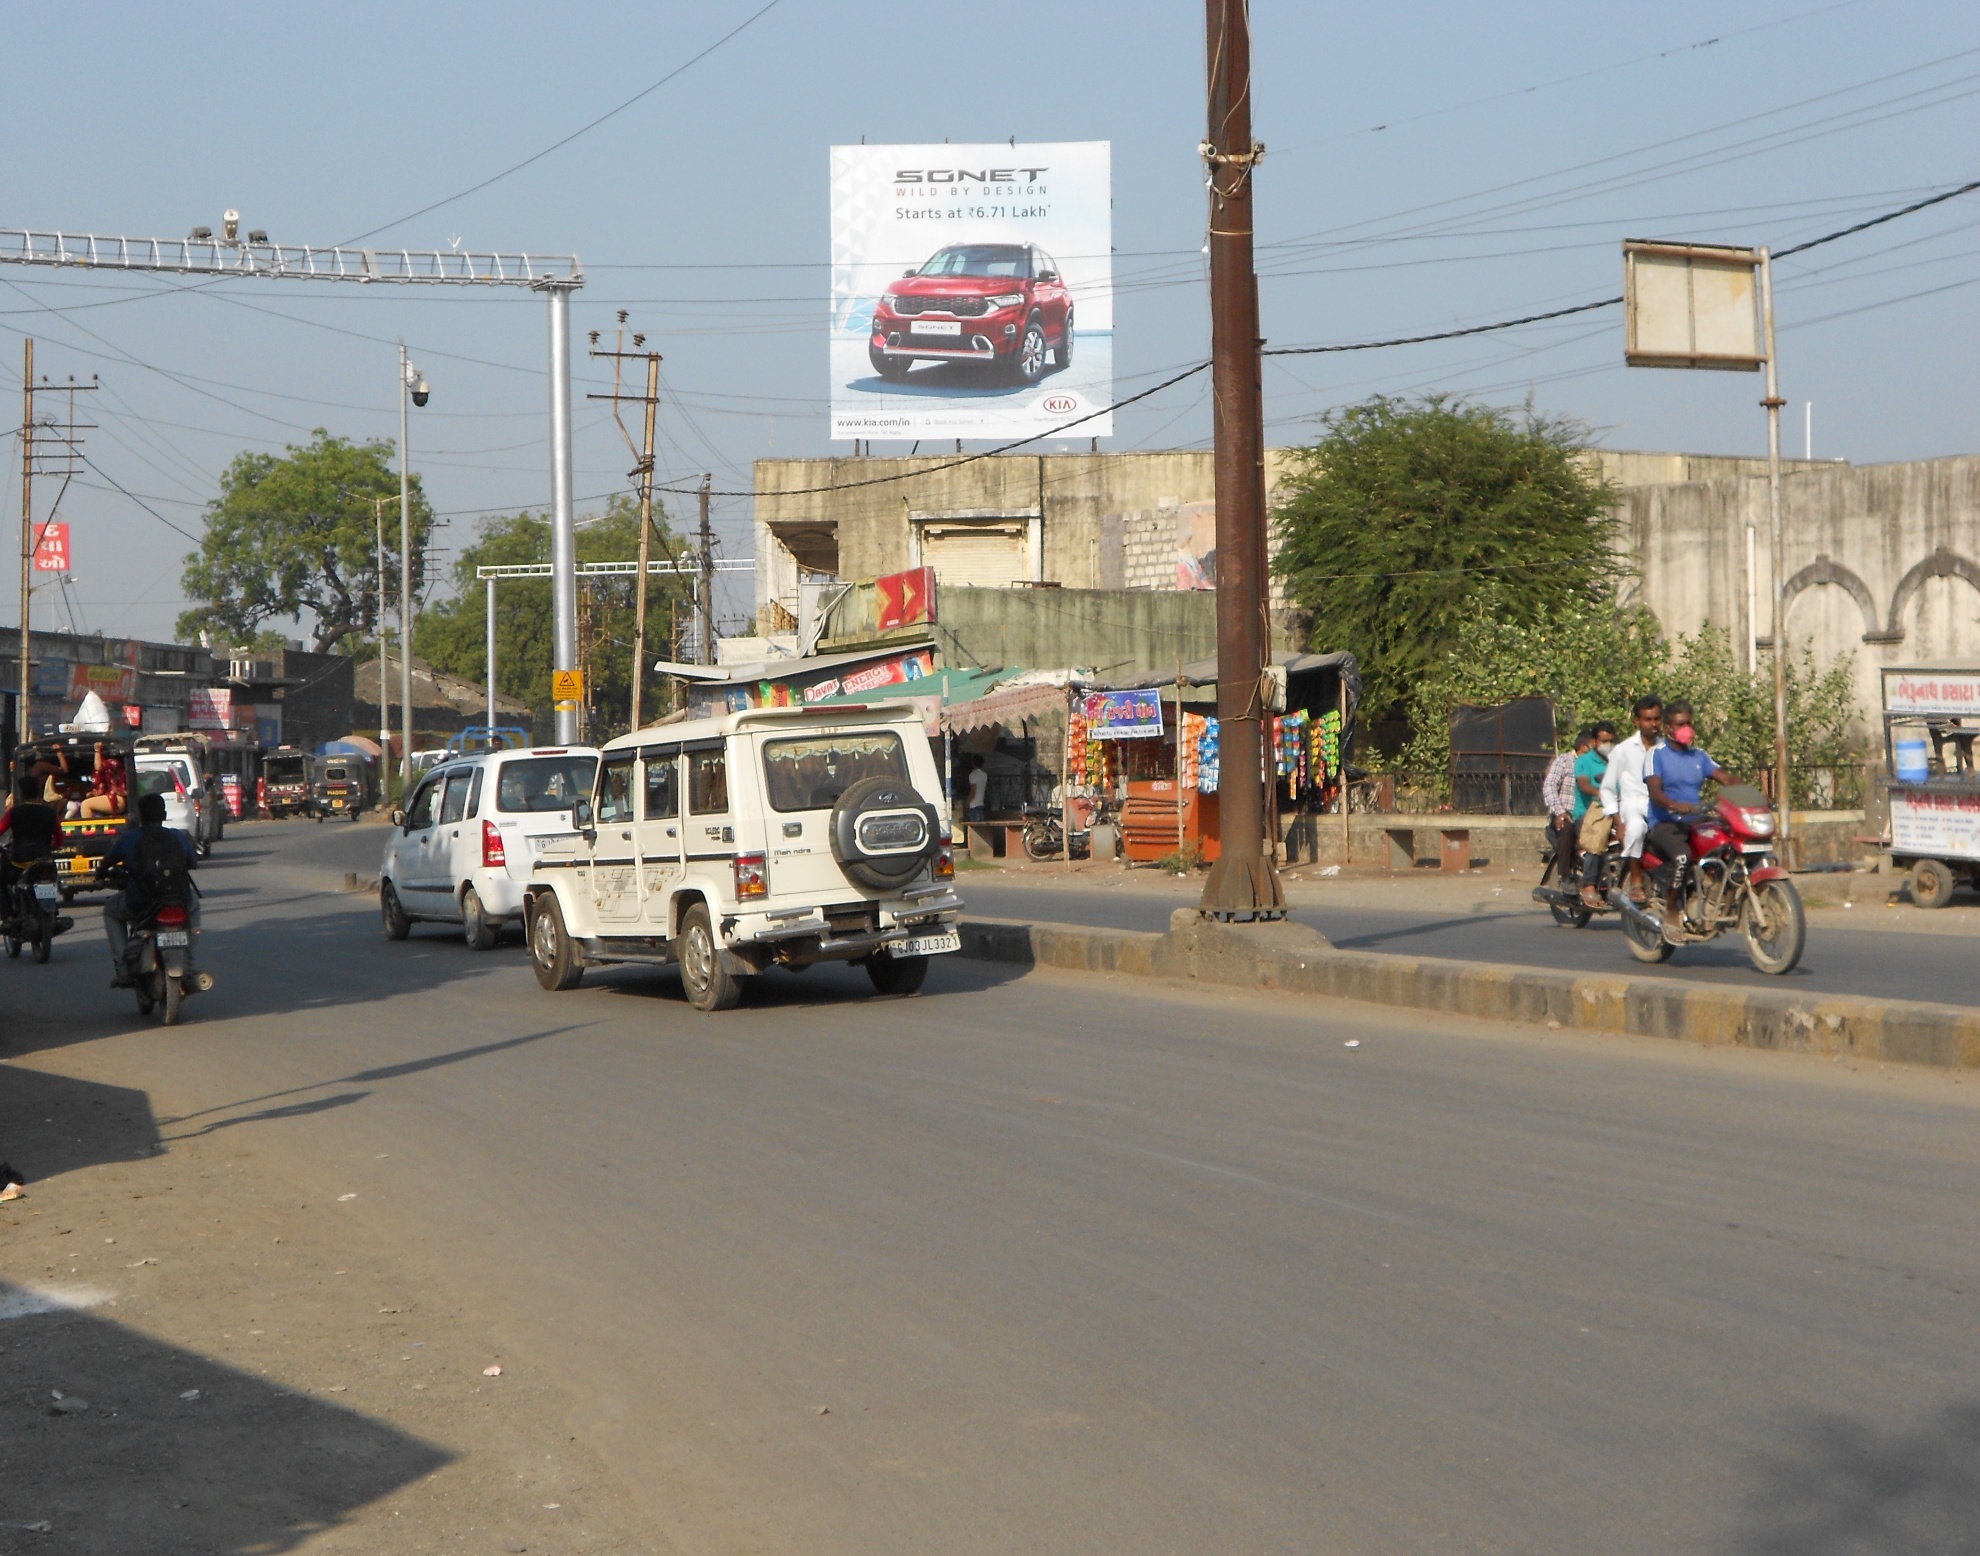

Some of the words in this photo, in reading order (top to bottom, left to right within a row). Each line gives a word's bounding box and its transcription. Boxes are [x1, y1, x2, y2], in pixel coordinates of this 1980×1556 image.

[893, 168, 1050, 183] SONET
[896, 187, 937, 196] WILD
[950, 186, 970, 195] BY
[983, 185, 1047, 195] DESIGN
[896, 208, 941, 219] Starts
[947, 208, 962, 219] at
[969, 206, 1005, 218] ₹6.71
[837, 417, 910, 427] www.kia.com/in
[843, 665, 887, 691] ENERGY
[61, 824, 118, 837] TUL
[898, 937, 958, 954] GJ03JL3321
